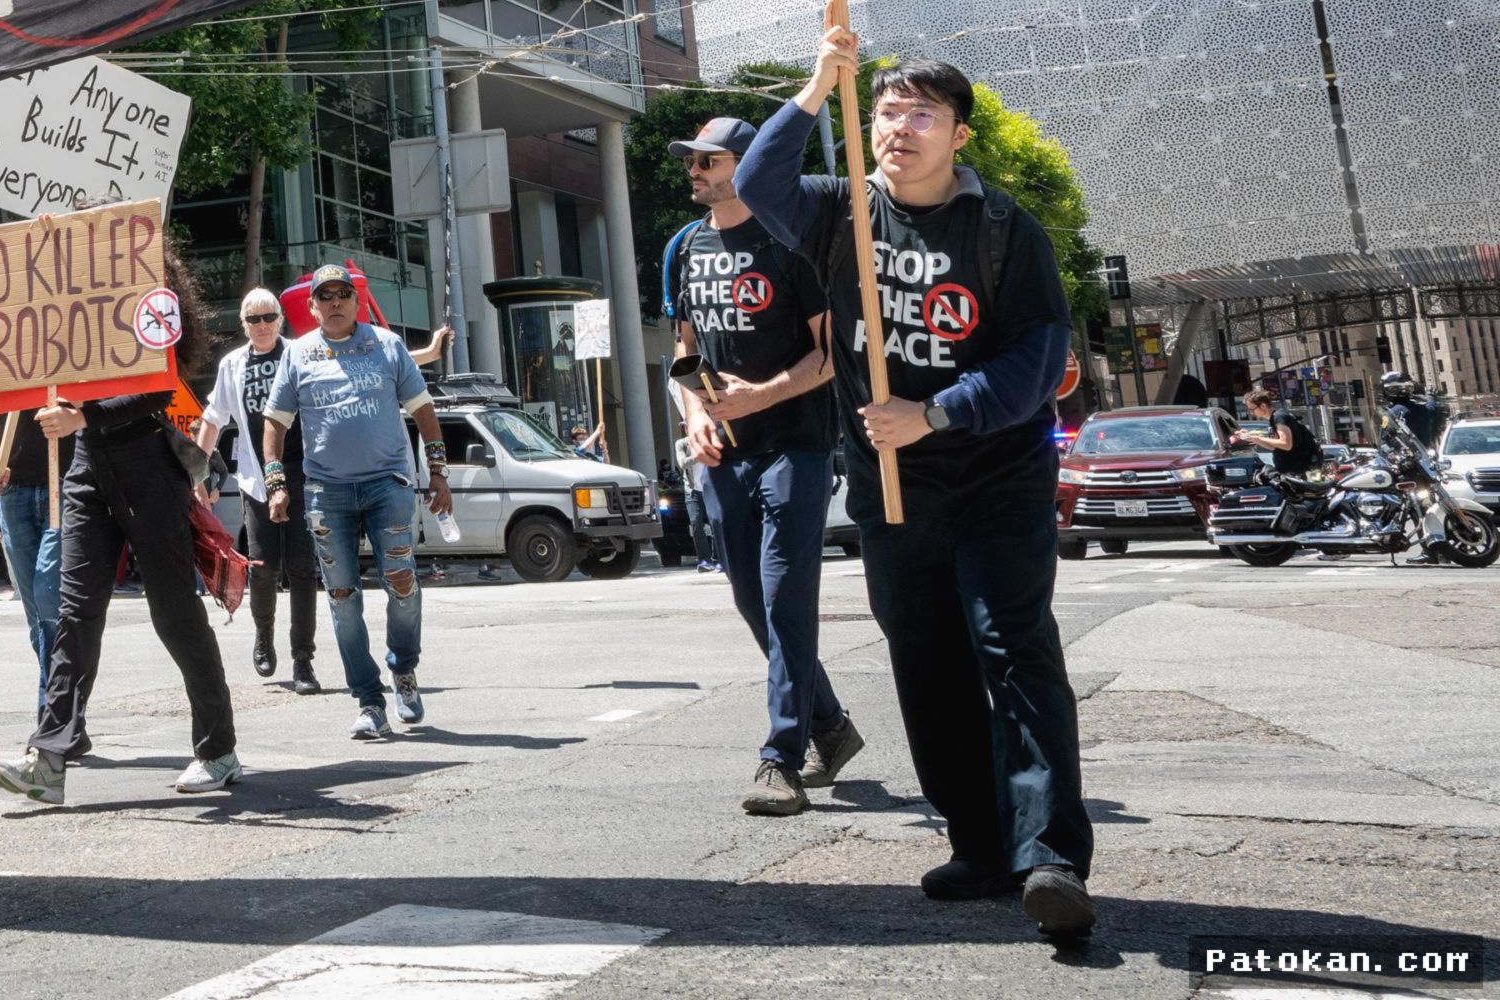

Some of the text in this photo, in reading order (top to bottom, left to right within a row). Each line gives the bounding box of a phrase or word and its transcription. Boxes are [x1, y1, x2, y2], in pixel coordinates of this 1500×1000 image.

[70, 64, 170, 137] Anyone
[21, 94, 88, 153] Builds
[25, 215, 159, 303] KILLER
[688, 251, 754, 278] STOP
[687, 279, 765, 306] THE AI
[690, 307, 756, 333] RACE
[931, 294, 970, 329] AI
[246, 398, 269, 414] RA
[324, 399, 380, 424] ENOUGH!
